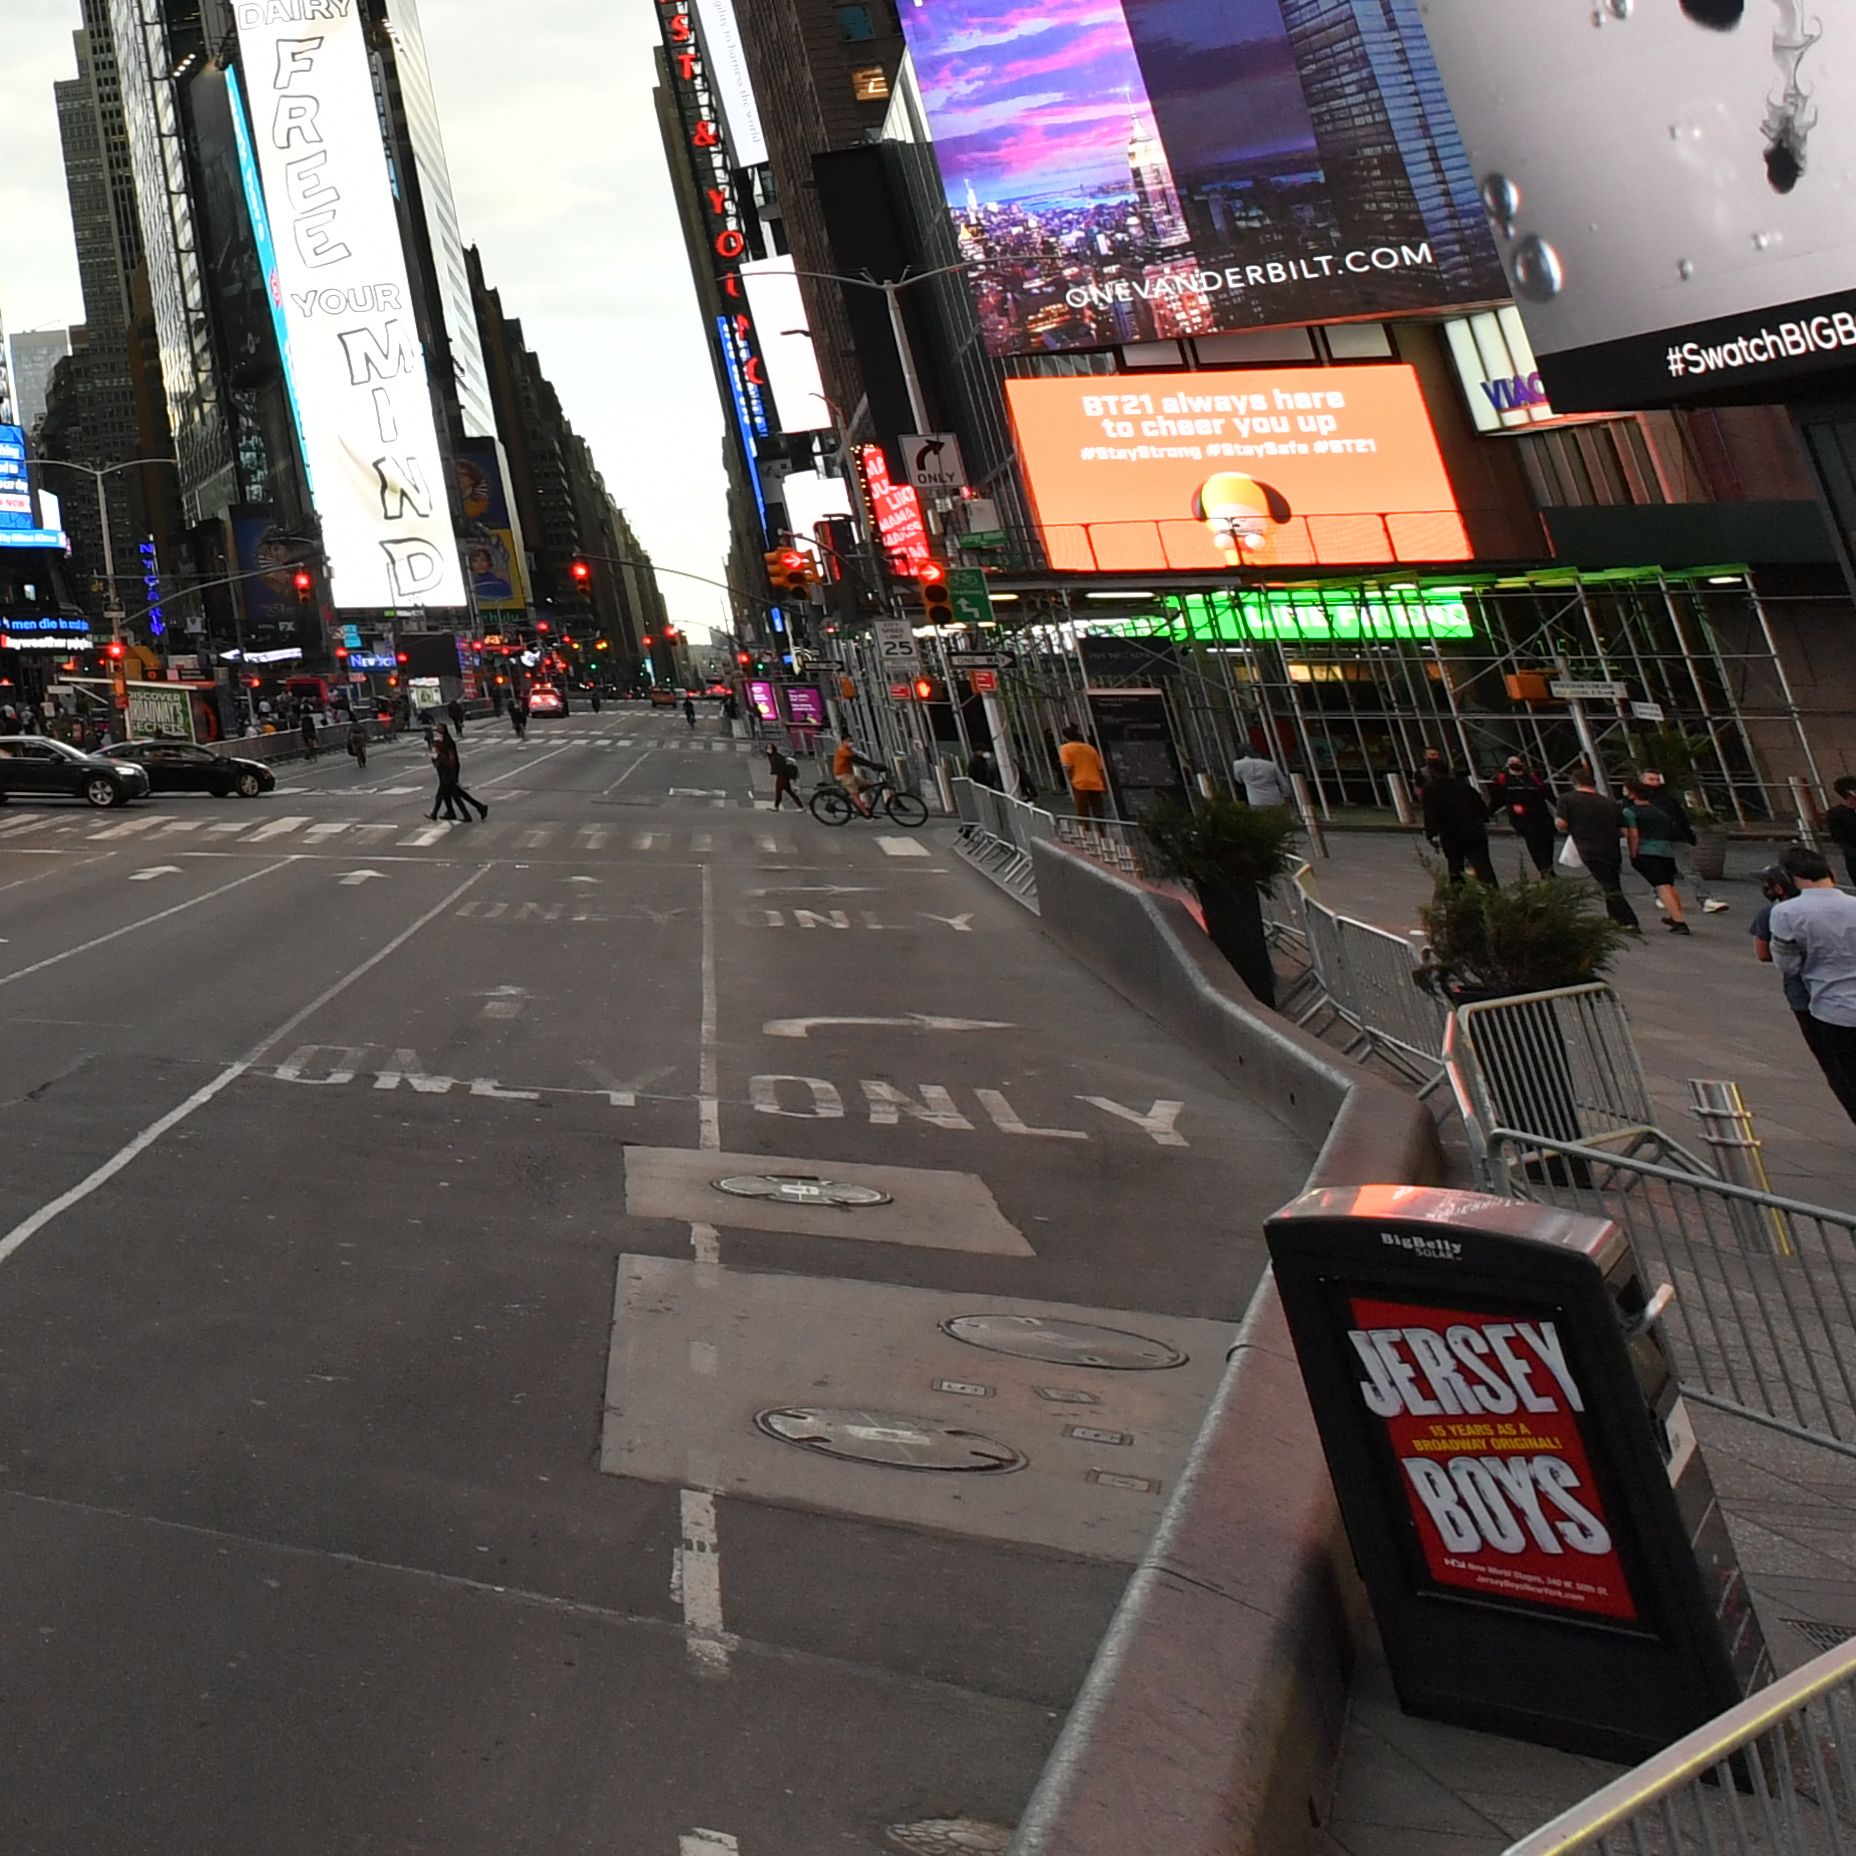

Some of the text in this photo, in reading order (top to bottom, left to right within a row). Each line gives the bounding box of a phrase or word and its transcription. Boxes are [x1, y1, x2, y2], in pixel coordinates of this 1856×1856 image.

[723, 30, 732, 42] to
[727, 42, 746, 89] harness
[740, 88, 751, 109] the
[692, 119, 719, 147] &
[745, 109, 762, 145] world
[272, 36, 352, 269] FREE
[1064, 242, 1434, 311] ONEVANDERBILT.COM
[291, 282, 402, 318] YOUR
[1080, 388, 1346, 418] BT21 always here
[1100, 412, 1338, 440] to cheer you up
[338, 318, 445, 597] MIND
[1079, 438, 1377, 462] #StayStrong #StaySafe #BT21
[916, 472, 956, 485] ONLY
[278, 621, 296, 632] FX
[488, 612, 520, 623] hulu
[884, 642, 914, 656] 25
[956, 654, 1008, 665] ONE WAY
[127, 690, 181, 702] DISCOVER
[740, 908, 976, 932] ONLY
[272, 1041, 1190, 1147] ONLY ONLY
[1380, 1232, 1463, 1255] BigBelly
[1414, 1246, 1455, 1260] SOLAR
[1347, 1321, 1585, 1418] JERSEY
[1428, 1422, 1532, 1437] 15 YEARS AS A
[1413, 1437, 1563, 1452] BROADWAY ORIGINAL!
[1401, 1454, 1613, 1556] BOYS
[1467, 1562, 1486, 1574] New
[1486, 1565, 1512, 1579] World
